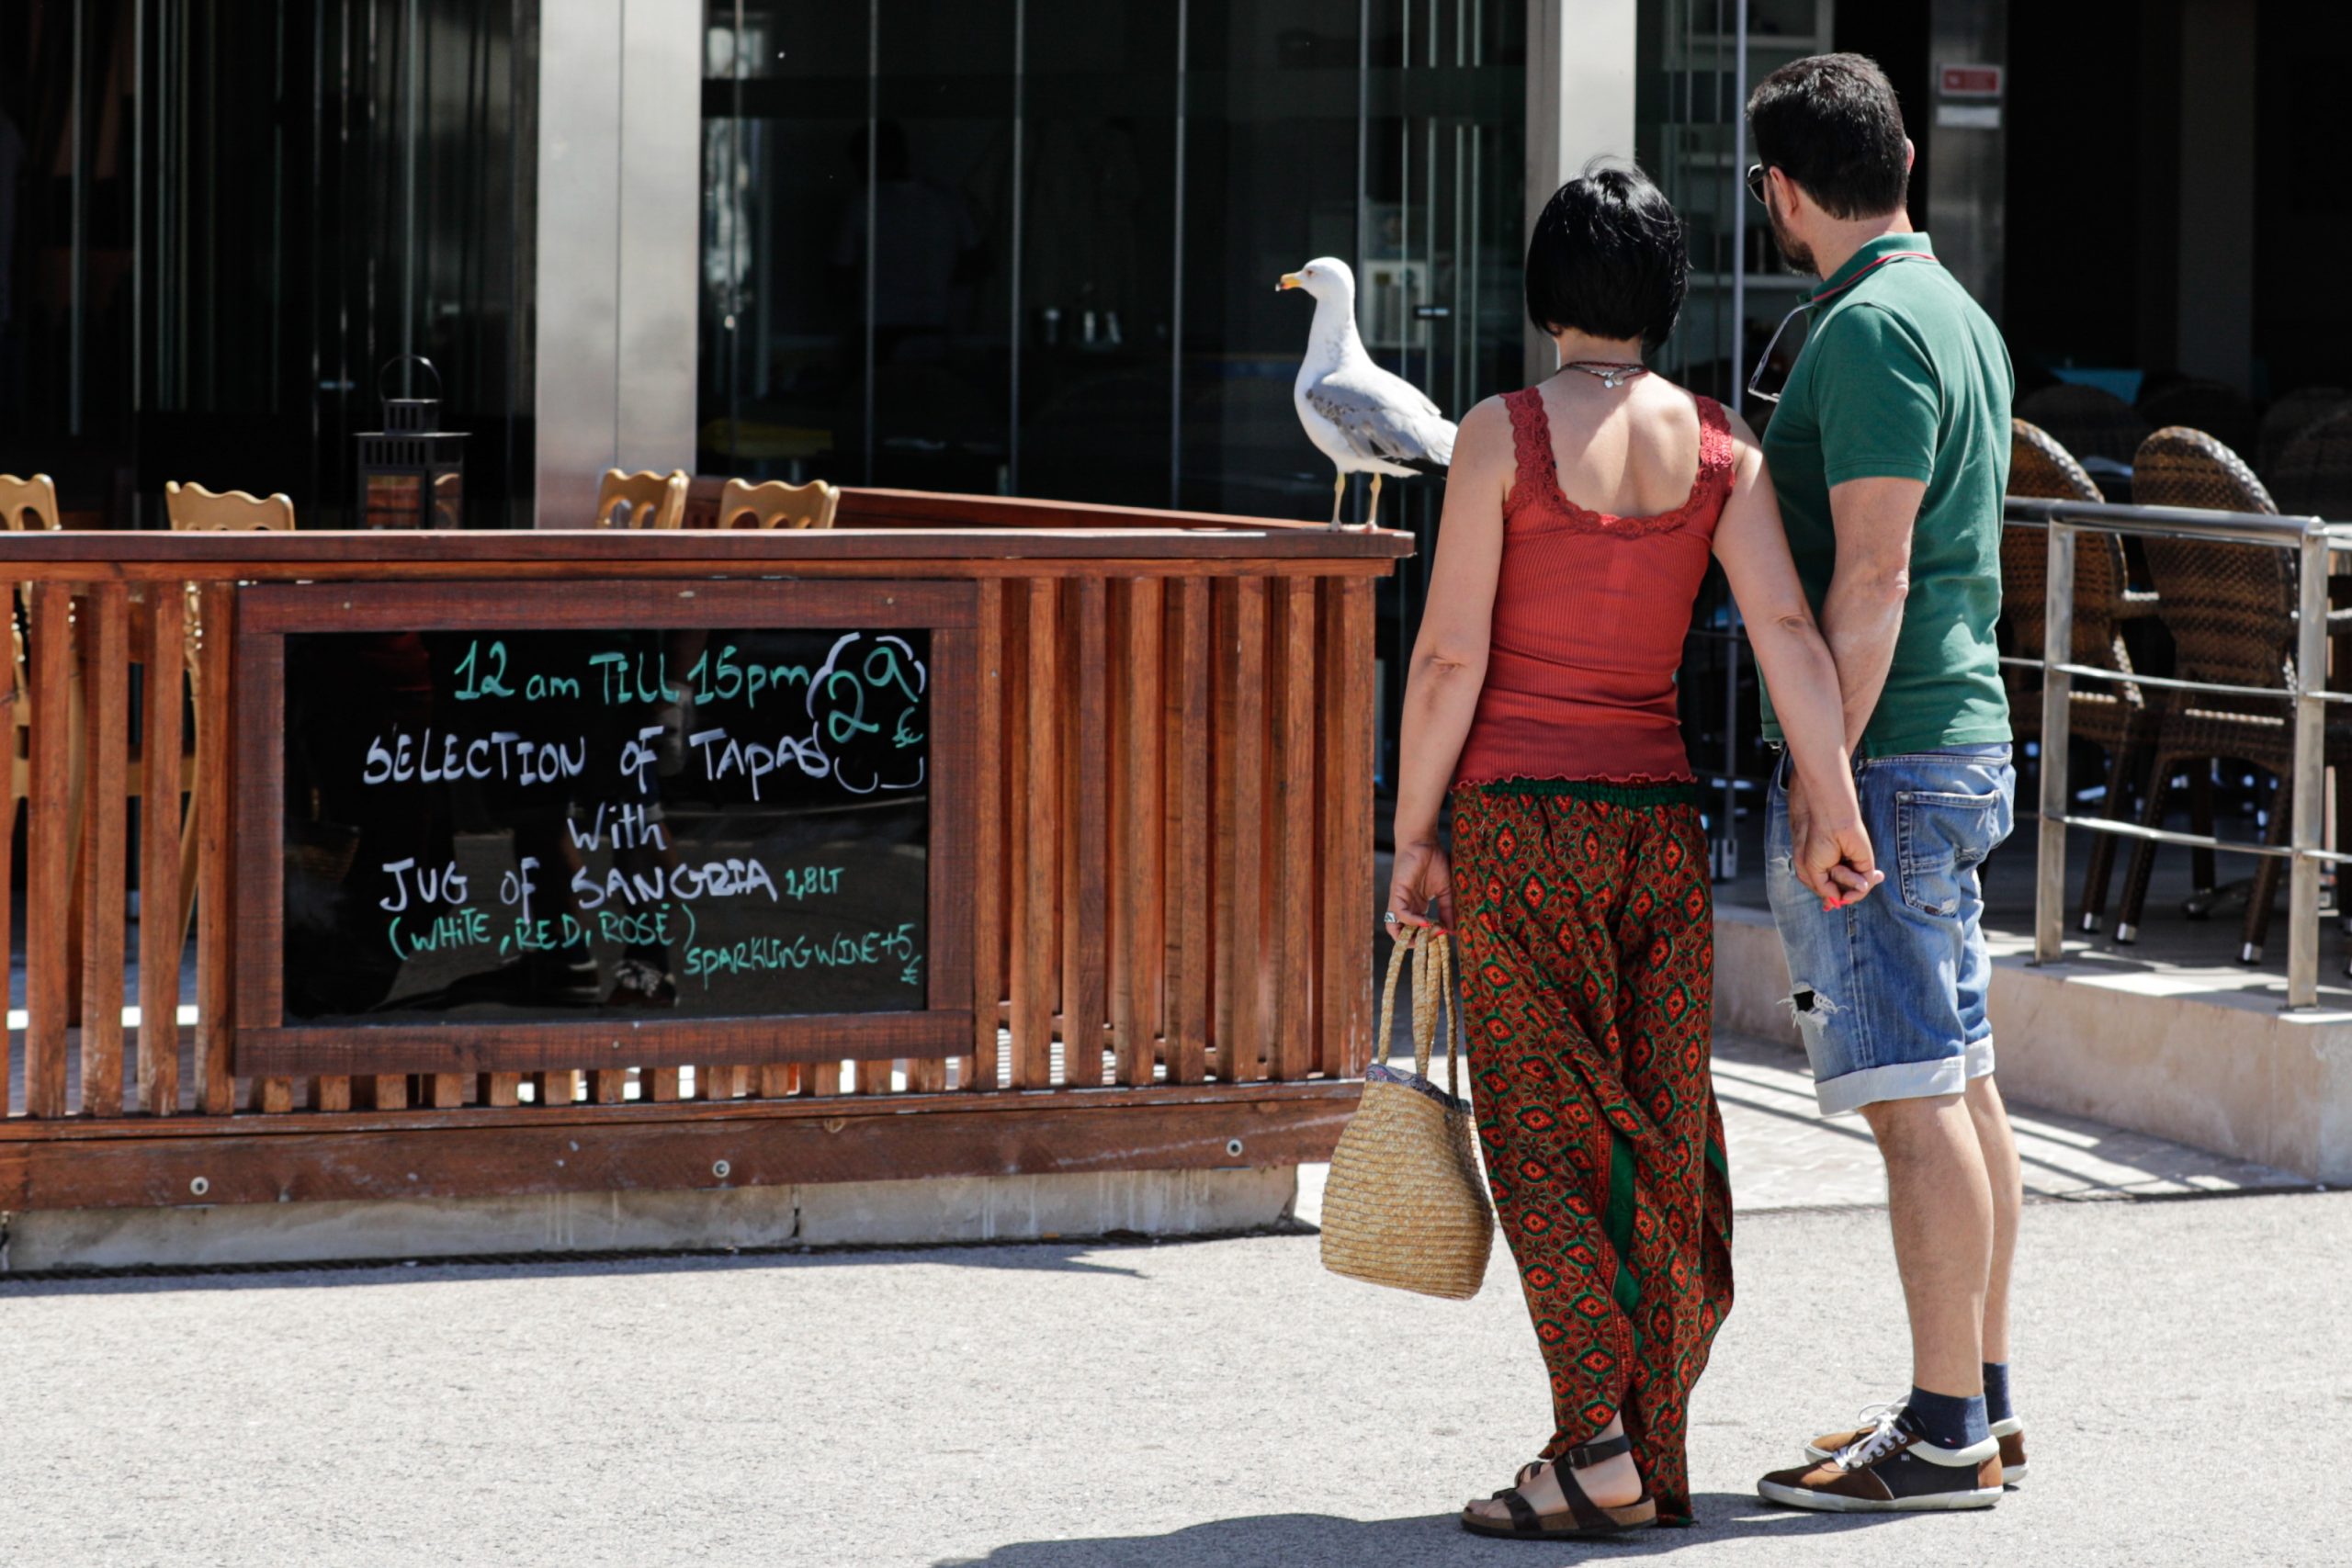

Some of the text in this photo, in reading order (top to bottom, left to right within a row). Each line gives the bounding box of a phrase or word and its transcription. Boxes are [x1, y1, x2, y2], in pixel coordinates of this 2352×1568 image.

[454, 640, 515, 700] 12
[526, 674, 581, 701] am
[687, 645, 810, 710] 15pm
[363, 728, 586, 786] SELECTION
[619, 726, 664, 795] OF
[568, 802, 668, 852] With
[379, 857, 468, 912] JUG
[501, 856, 540, 924] OF
[814, 931, 880, 967] WINE
